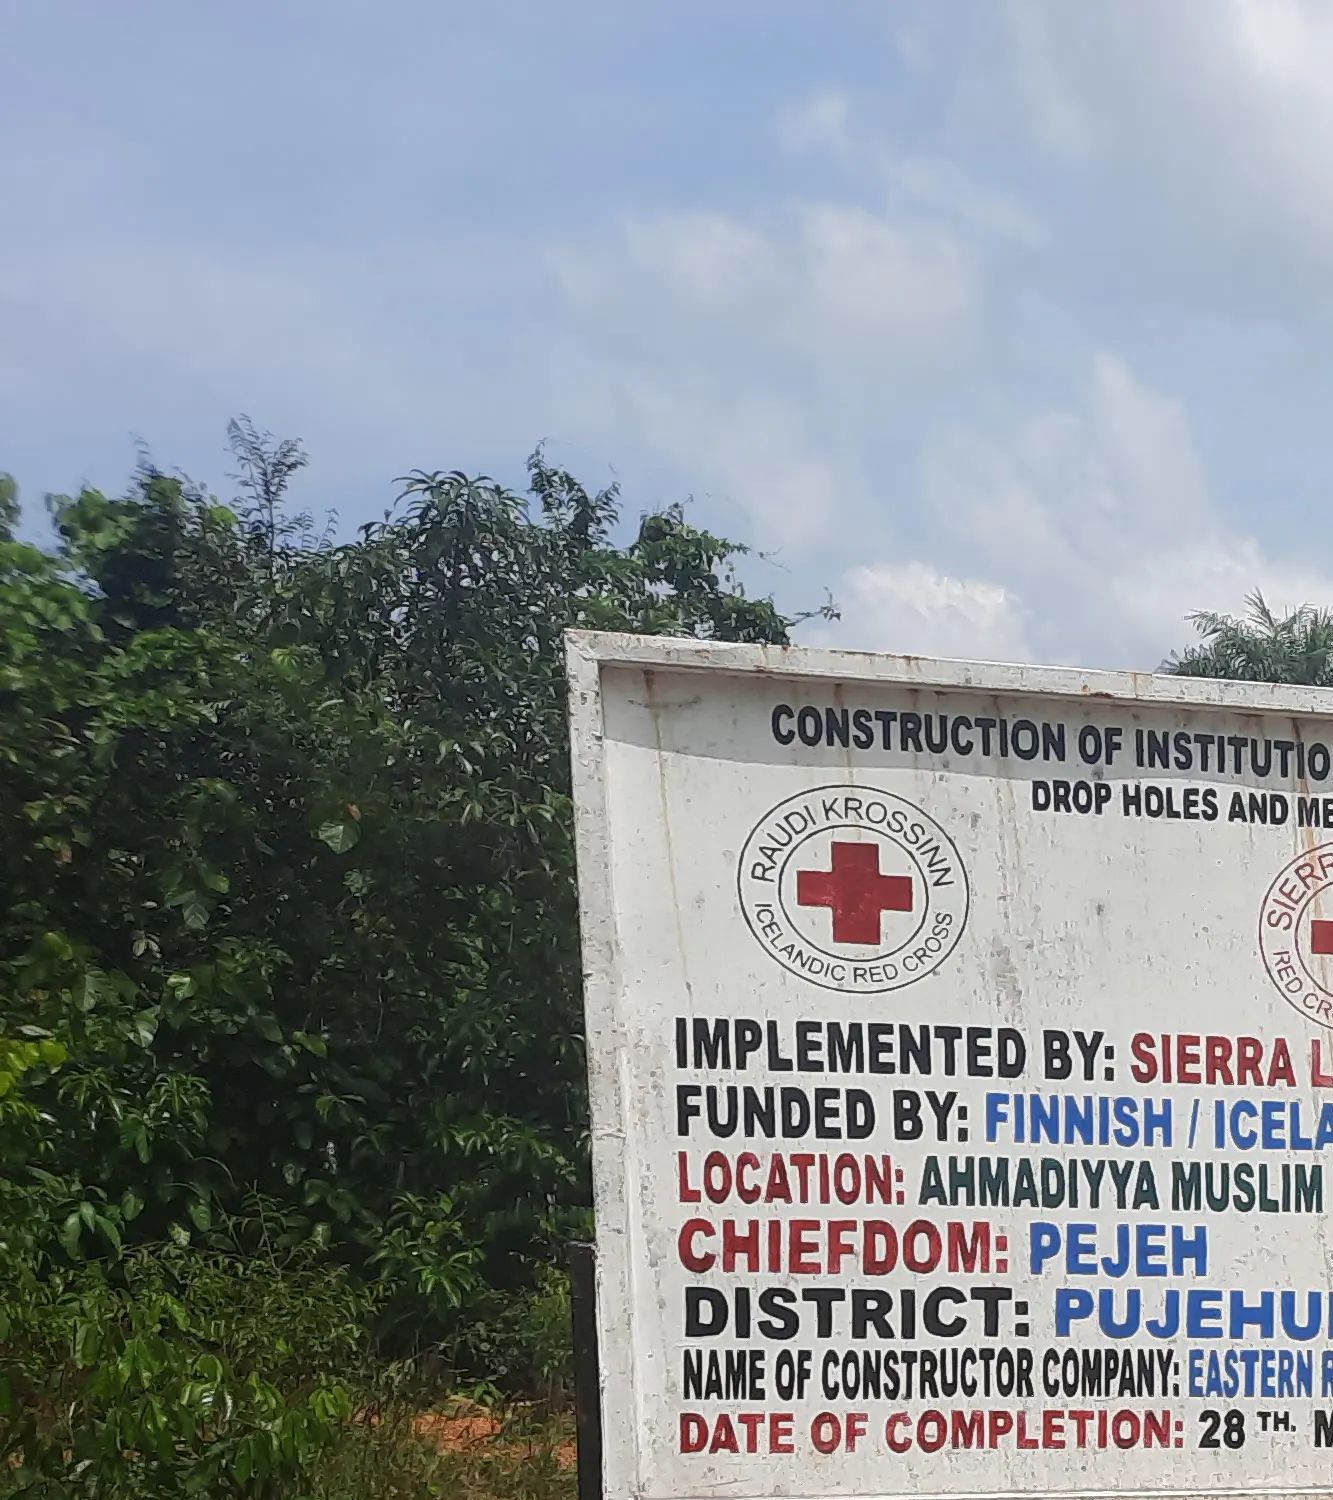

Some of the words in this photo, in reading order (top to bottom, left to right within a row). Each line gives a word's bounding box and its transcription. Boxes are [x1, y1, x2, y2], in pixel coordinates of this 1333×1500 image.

[771, 704, 1066, 761] CONSTRUCTION
[1078, 725, 1122, 765] OF
[1032, 780, 1111, 815] DROP
[1123, 784, 1218, 821] HOLES
[1228, 792, 1288, 825] AND
[751, 806, 816, 882] RAUDI
[822, 798, 954, 886] KROSSINN
[755, 903, 846, 981] ICELANDIC
[853, 964, 898, 984] RED
[902, 912, 953, 972] CROSS
[1273, 951, 1303, 993] RED
[676, 1018, 1026, 1078] IMPLEMENTED
[1044, 1030, 1114, 1081] BY:
[1131, 1033, 1296, 1087] SIERRA
[677, 1085, 875, 1139] FUNDED
[893, 1090, 968, 1142] BY:
[987, 1093, 1171, 1147] FINNISH
[679, 1151, 904, 1205] LOCATION:
[919, 1156, 1159, 1209] AHMADIYYA
[1172, 1162, 1323, 1213] MUSLIM
[678, 1218, 1008, 1276] CHIEFDOM:
[1030, 1223, 1207, 1278] PEJEH
[685, 1287, 1029, 1340] DISTRICT:
[684, 1349, 765, 1400] NAME
[775, 1349, 812, 1401] OF
[822, 1347, 1034, 1400] CONSTRUCTOR
[1043, 1348, 1179, 1397] COMPANY:
[1189, 1349, 1312, 1398] EASTERN
[680, 1413, 794, 1454] DATE
[811, 1412, 868, 1454] OF
[886, 1410, 1183, 1453] COMPLETION:
[1199, 1409, 1245, 1449] 28
